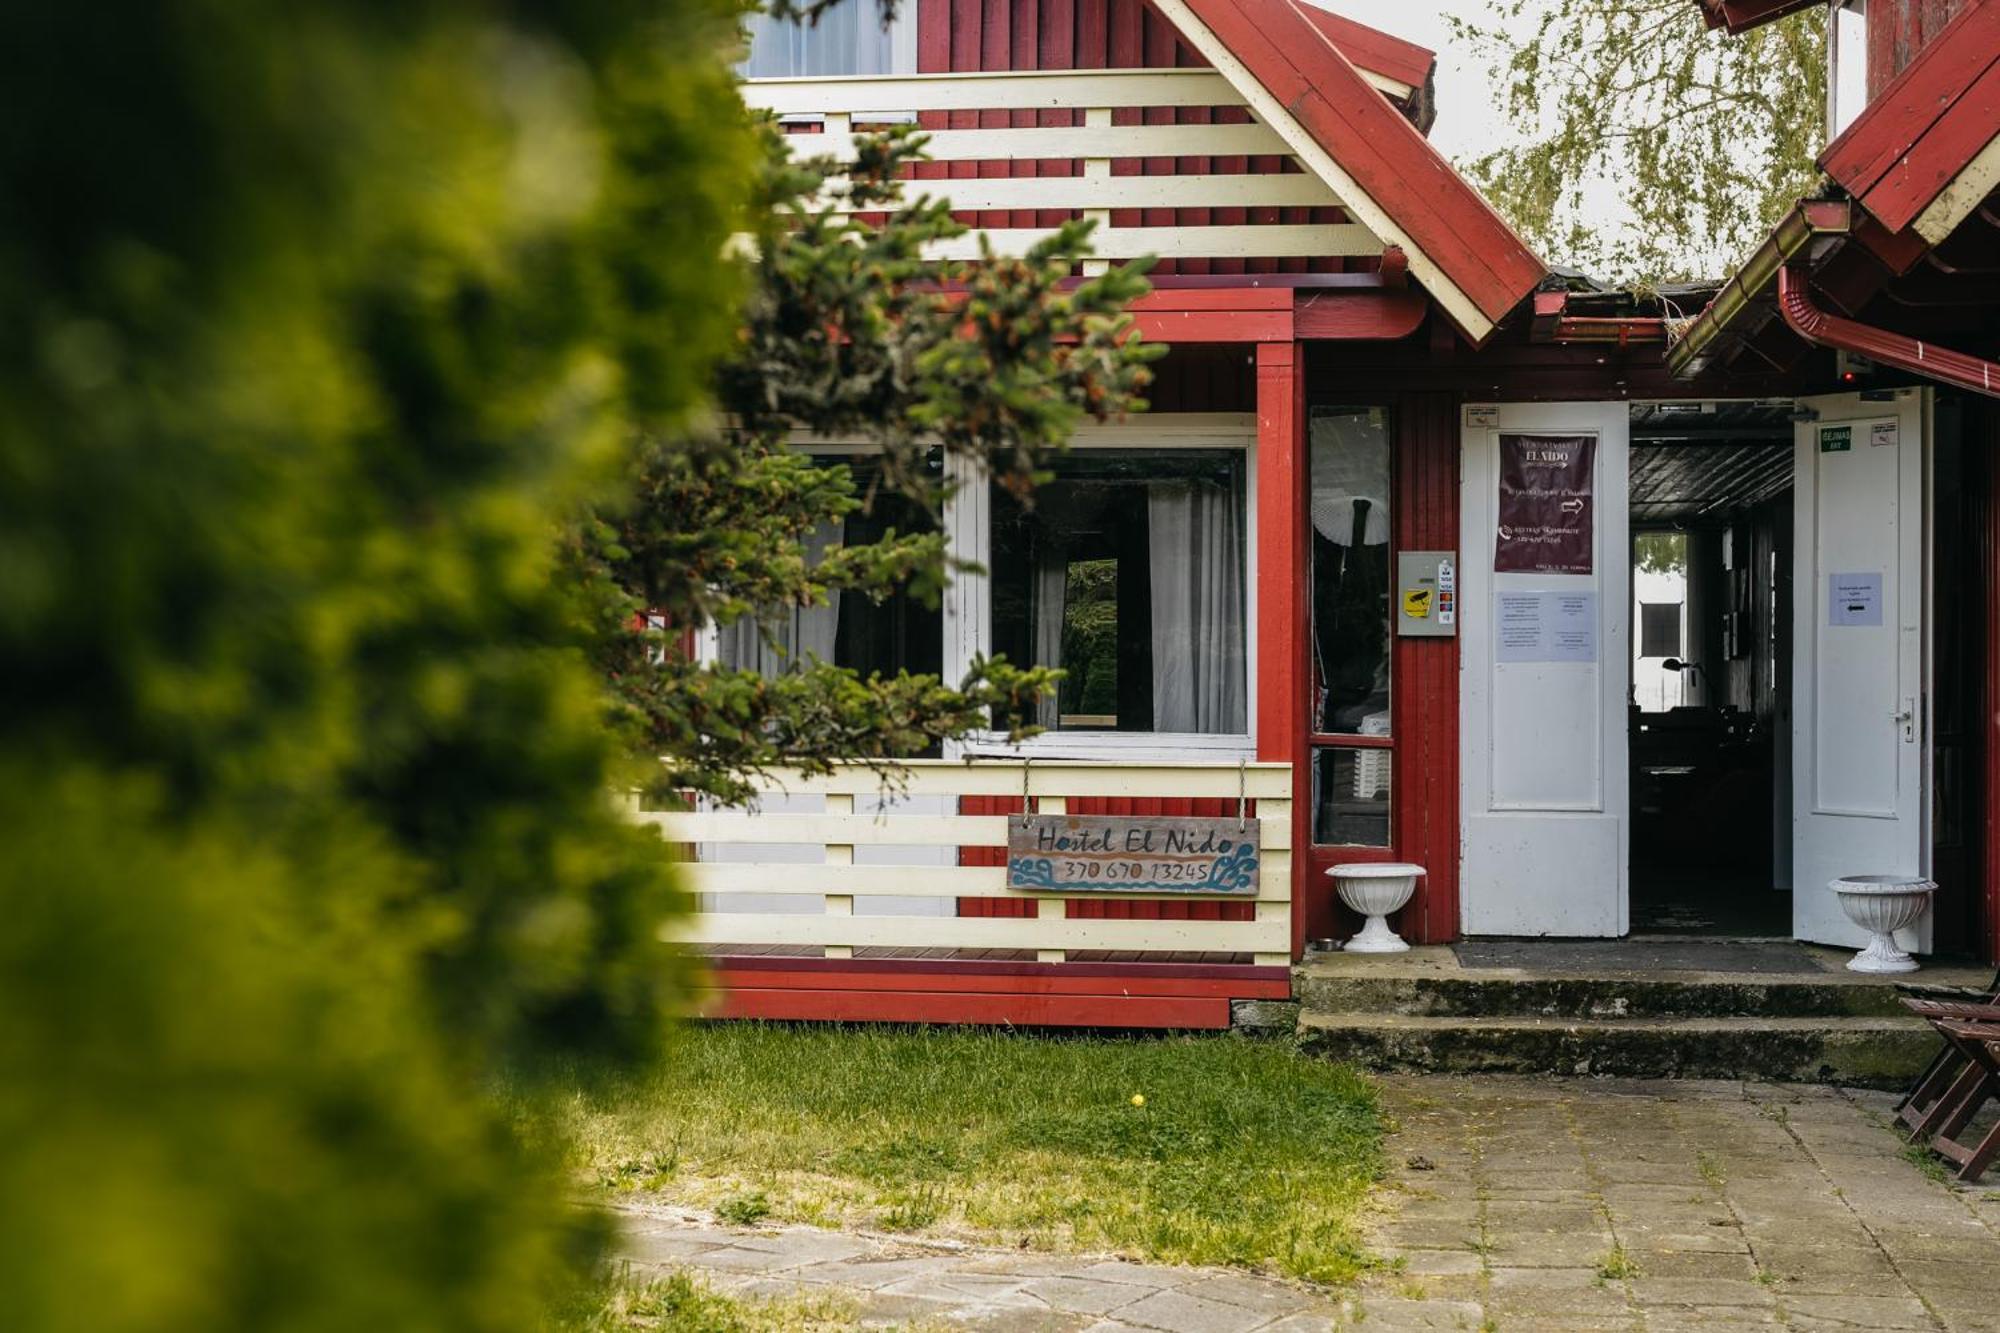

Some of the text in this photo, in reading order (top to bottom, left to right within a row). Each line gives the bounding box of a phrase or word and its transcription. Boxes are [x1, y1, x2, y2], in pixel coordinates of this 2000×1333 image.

[1038, 827, 1232, 854] Hostel El Nido
[1065, 861, 1209, 881] 370 670 13245
